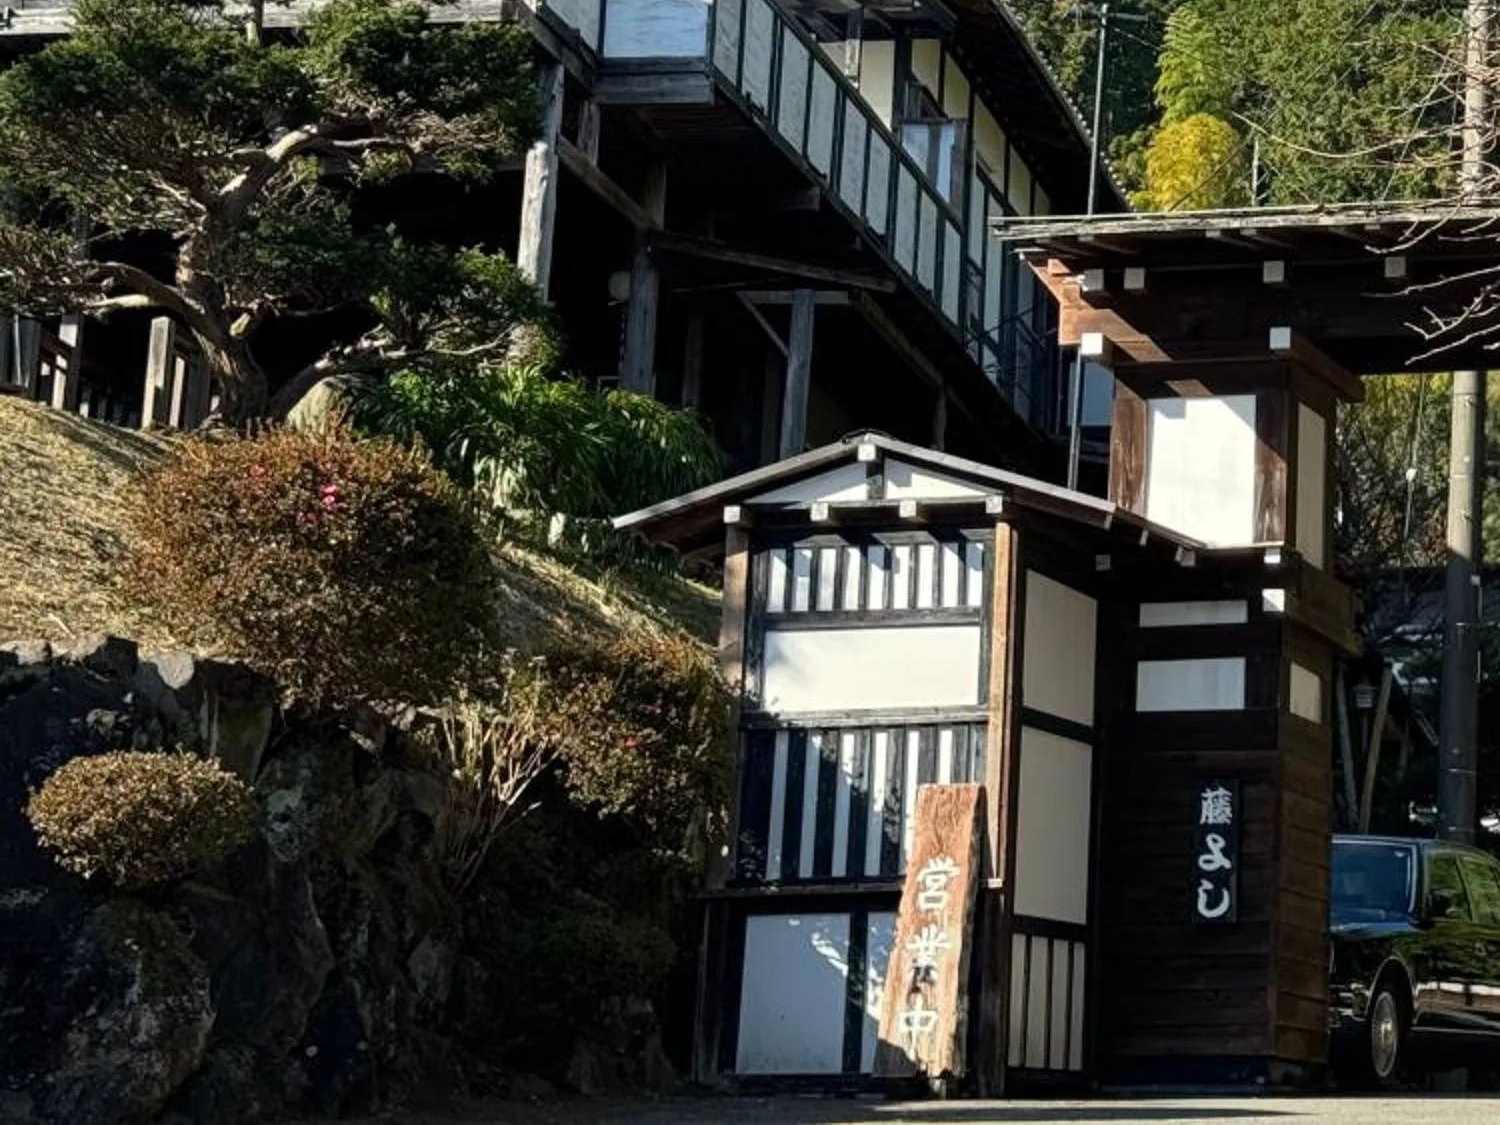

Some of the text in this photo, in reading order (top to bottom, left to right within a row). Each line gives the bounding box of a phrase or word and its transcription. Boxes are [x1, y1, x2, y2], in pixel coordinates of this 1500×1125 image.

[1197, 786, 1234, 919] 藤よし
[897, 855, 961, 1061] 営業中
